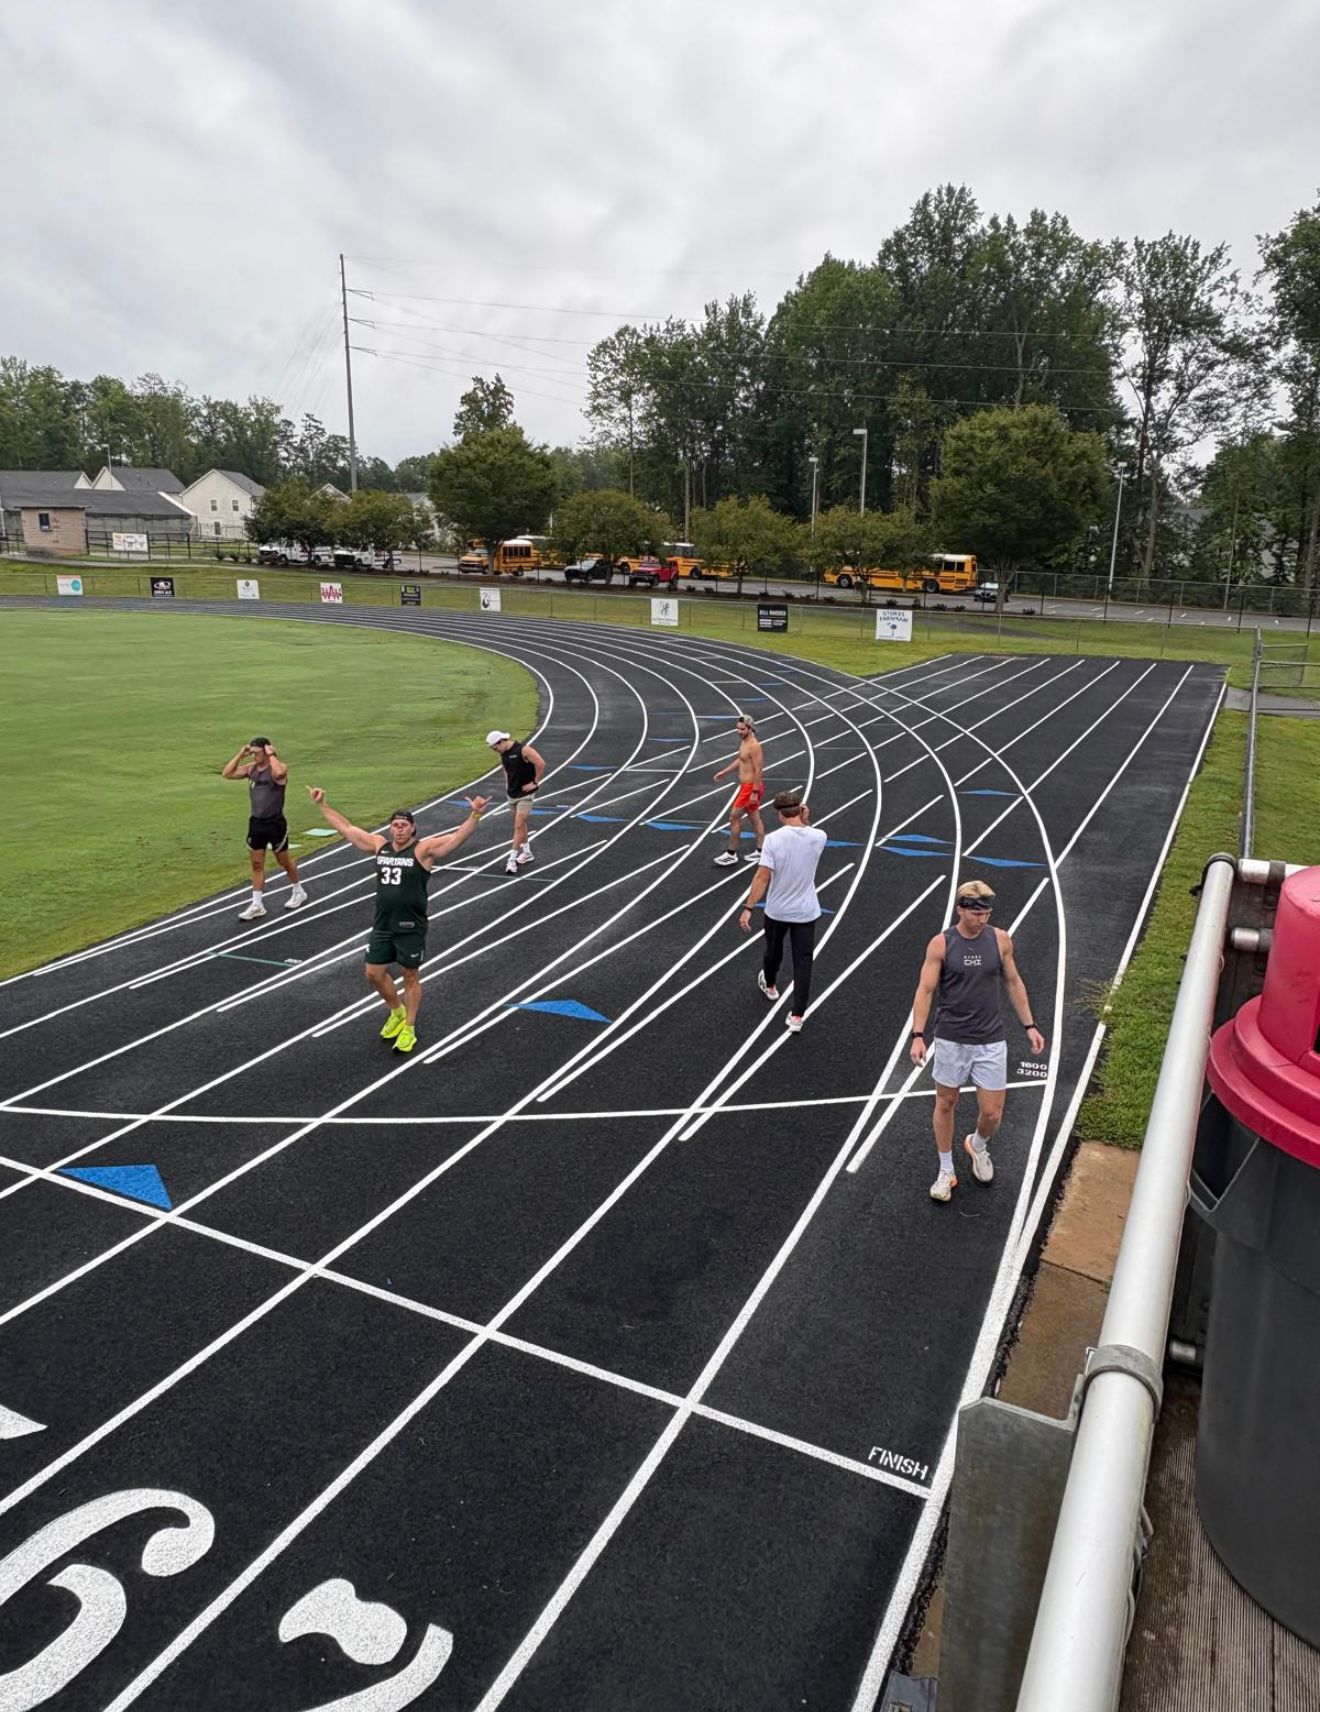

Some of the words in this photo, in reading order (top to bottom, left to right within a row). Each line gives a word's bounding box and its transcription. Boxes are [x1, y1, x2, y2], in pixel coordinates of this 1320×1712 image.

[377, 856, 414, 867] SPARTANS
[380, 867, 402, 885] 33
[1016, 1068, 1047, 1077] 3200
[867, 1445, 929, 1481] FINISH
